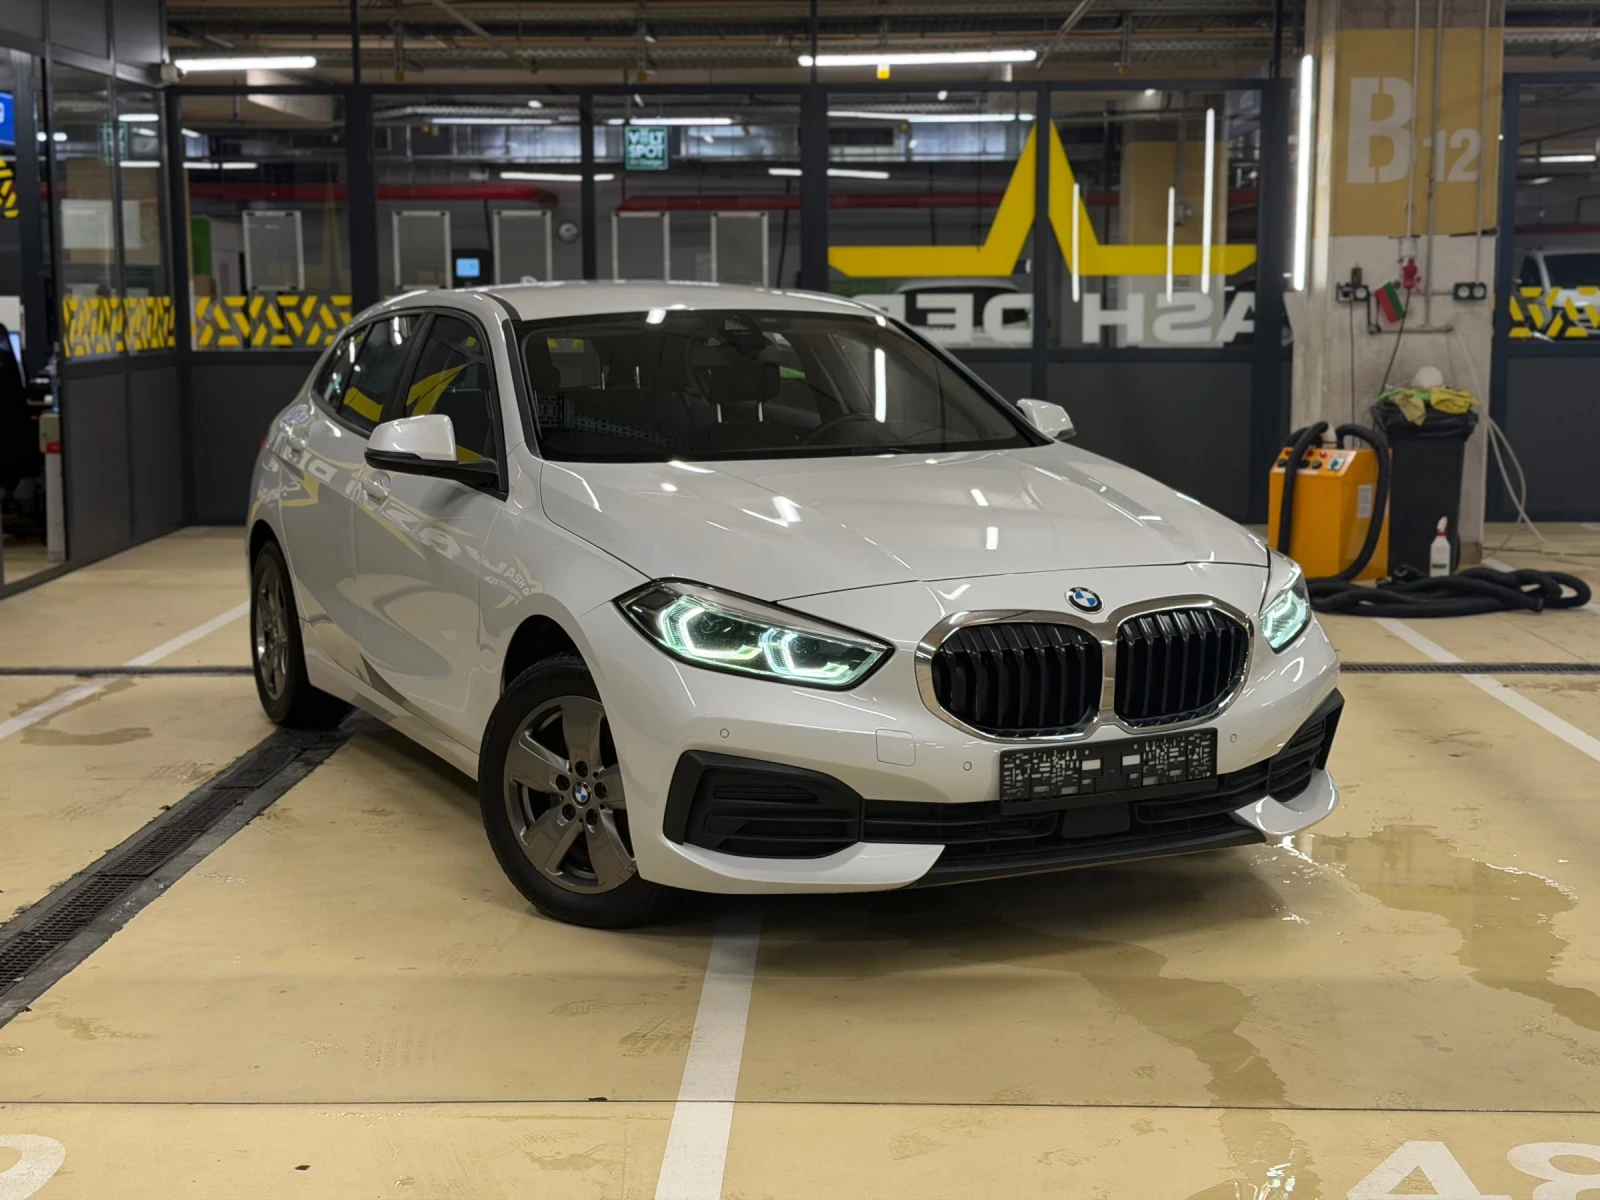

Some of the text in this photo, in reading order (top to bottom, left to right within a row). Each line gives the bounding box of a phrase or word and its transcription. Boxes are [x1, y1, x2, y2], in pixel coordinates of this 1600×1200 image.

[629, 144, 664, 158] SPOT
[1347, 77, 1481, 183] B 12
